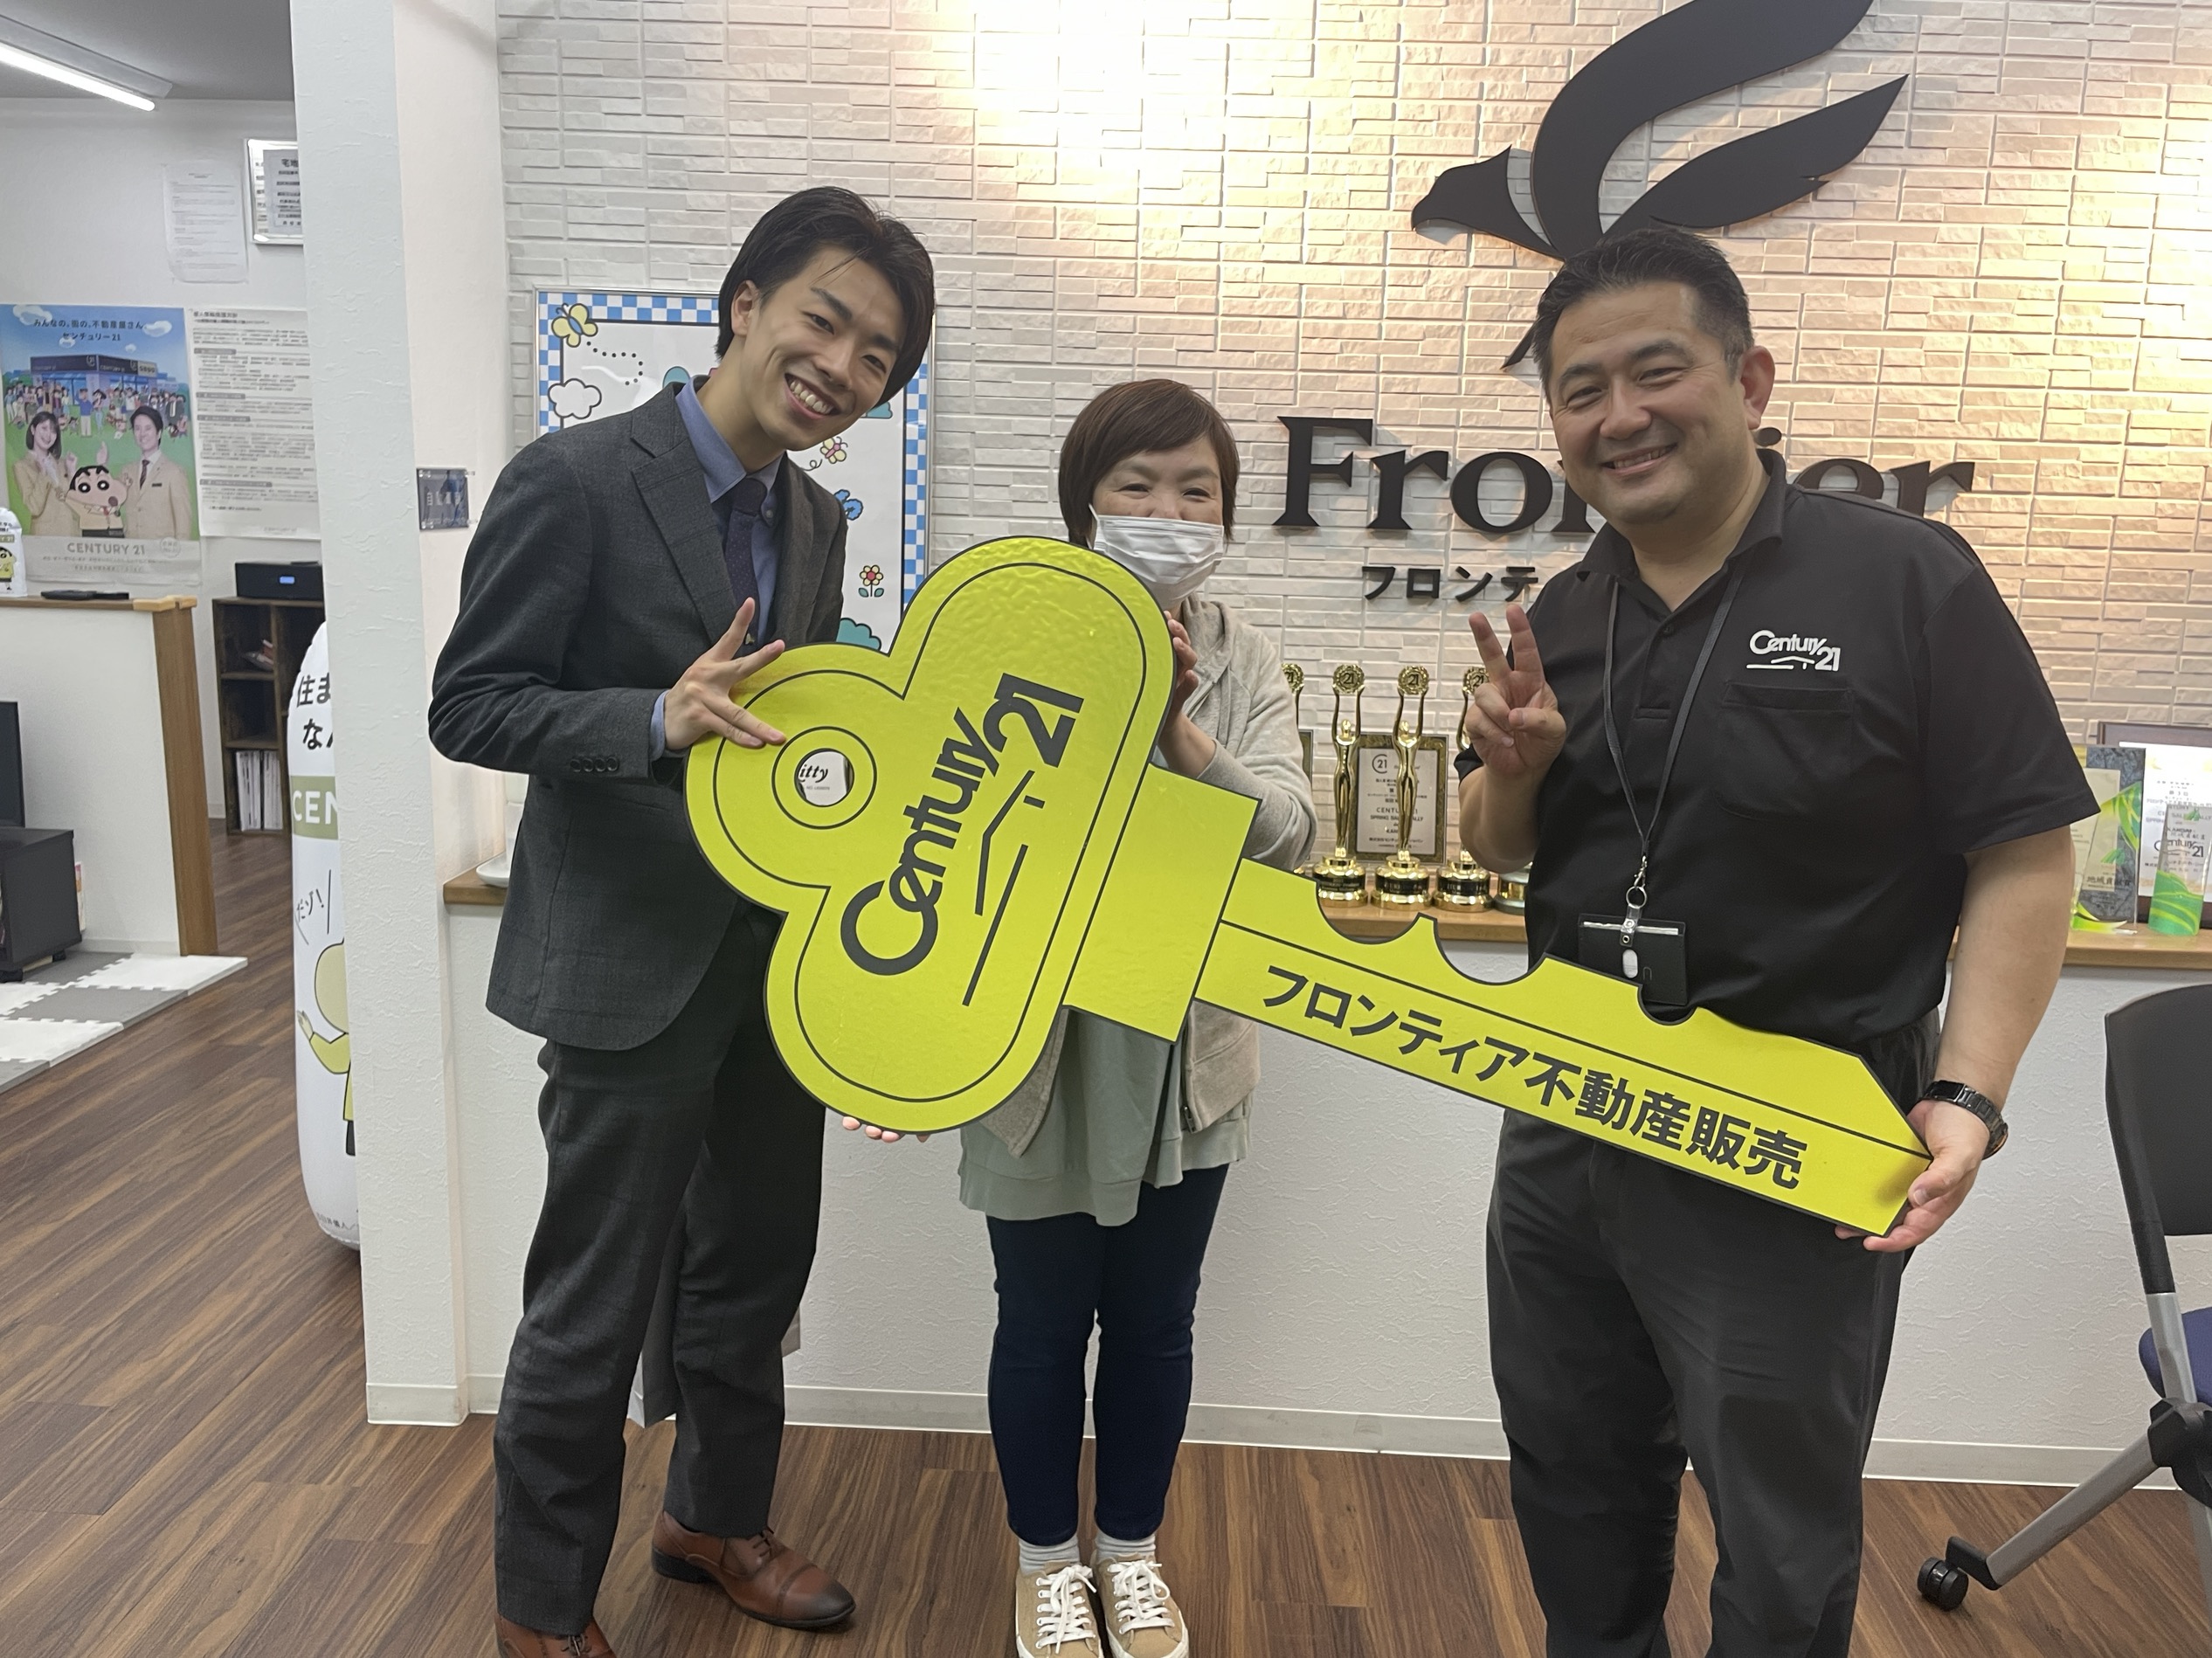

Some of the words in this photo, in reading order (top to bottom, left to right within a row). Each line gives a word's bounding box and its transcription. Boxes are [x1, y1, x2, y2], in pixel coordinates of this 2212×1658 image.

[66, 542, 129, 555] CENTURY
[133, 544, 145, 555] 21
[1749, 629, 1827, 655] Century
[1815, 646, 1841, 671] 21
[1343, 672, 1354, 685] 21
[1407, 674, 1420, 687] 21
[302, 718, 334, 750] な
[840, 707, 1000, 977] Century
[983, 672, 1085, 769] 21
[2192, 845, 2204, 858] 21
[1262, 964, 1809, 1190] フロンティア不動産販売
